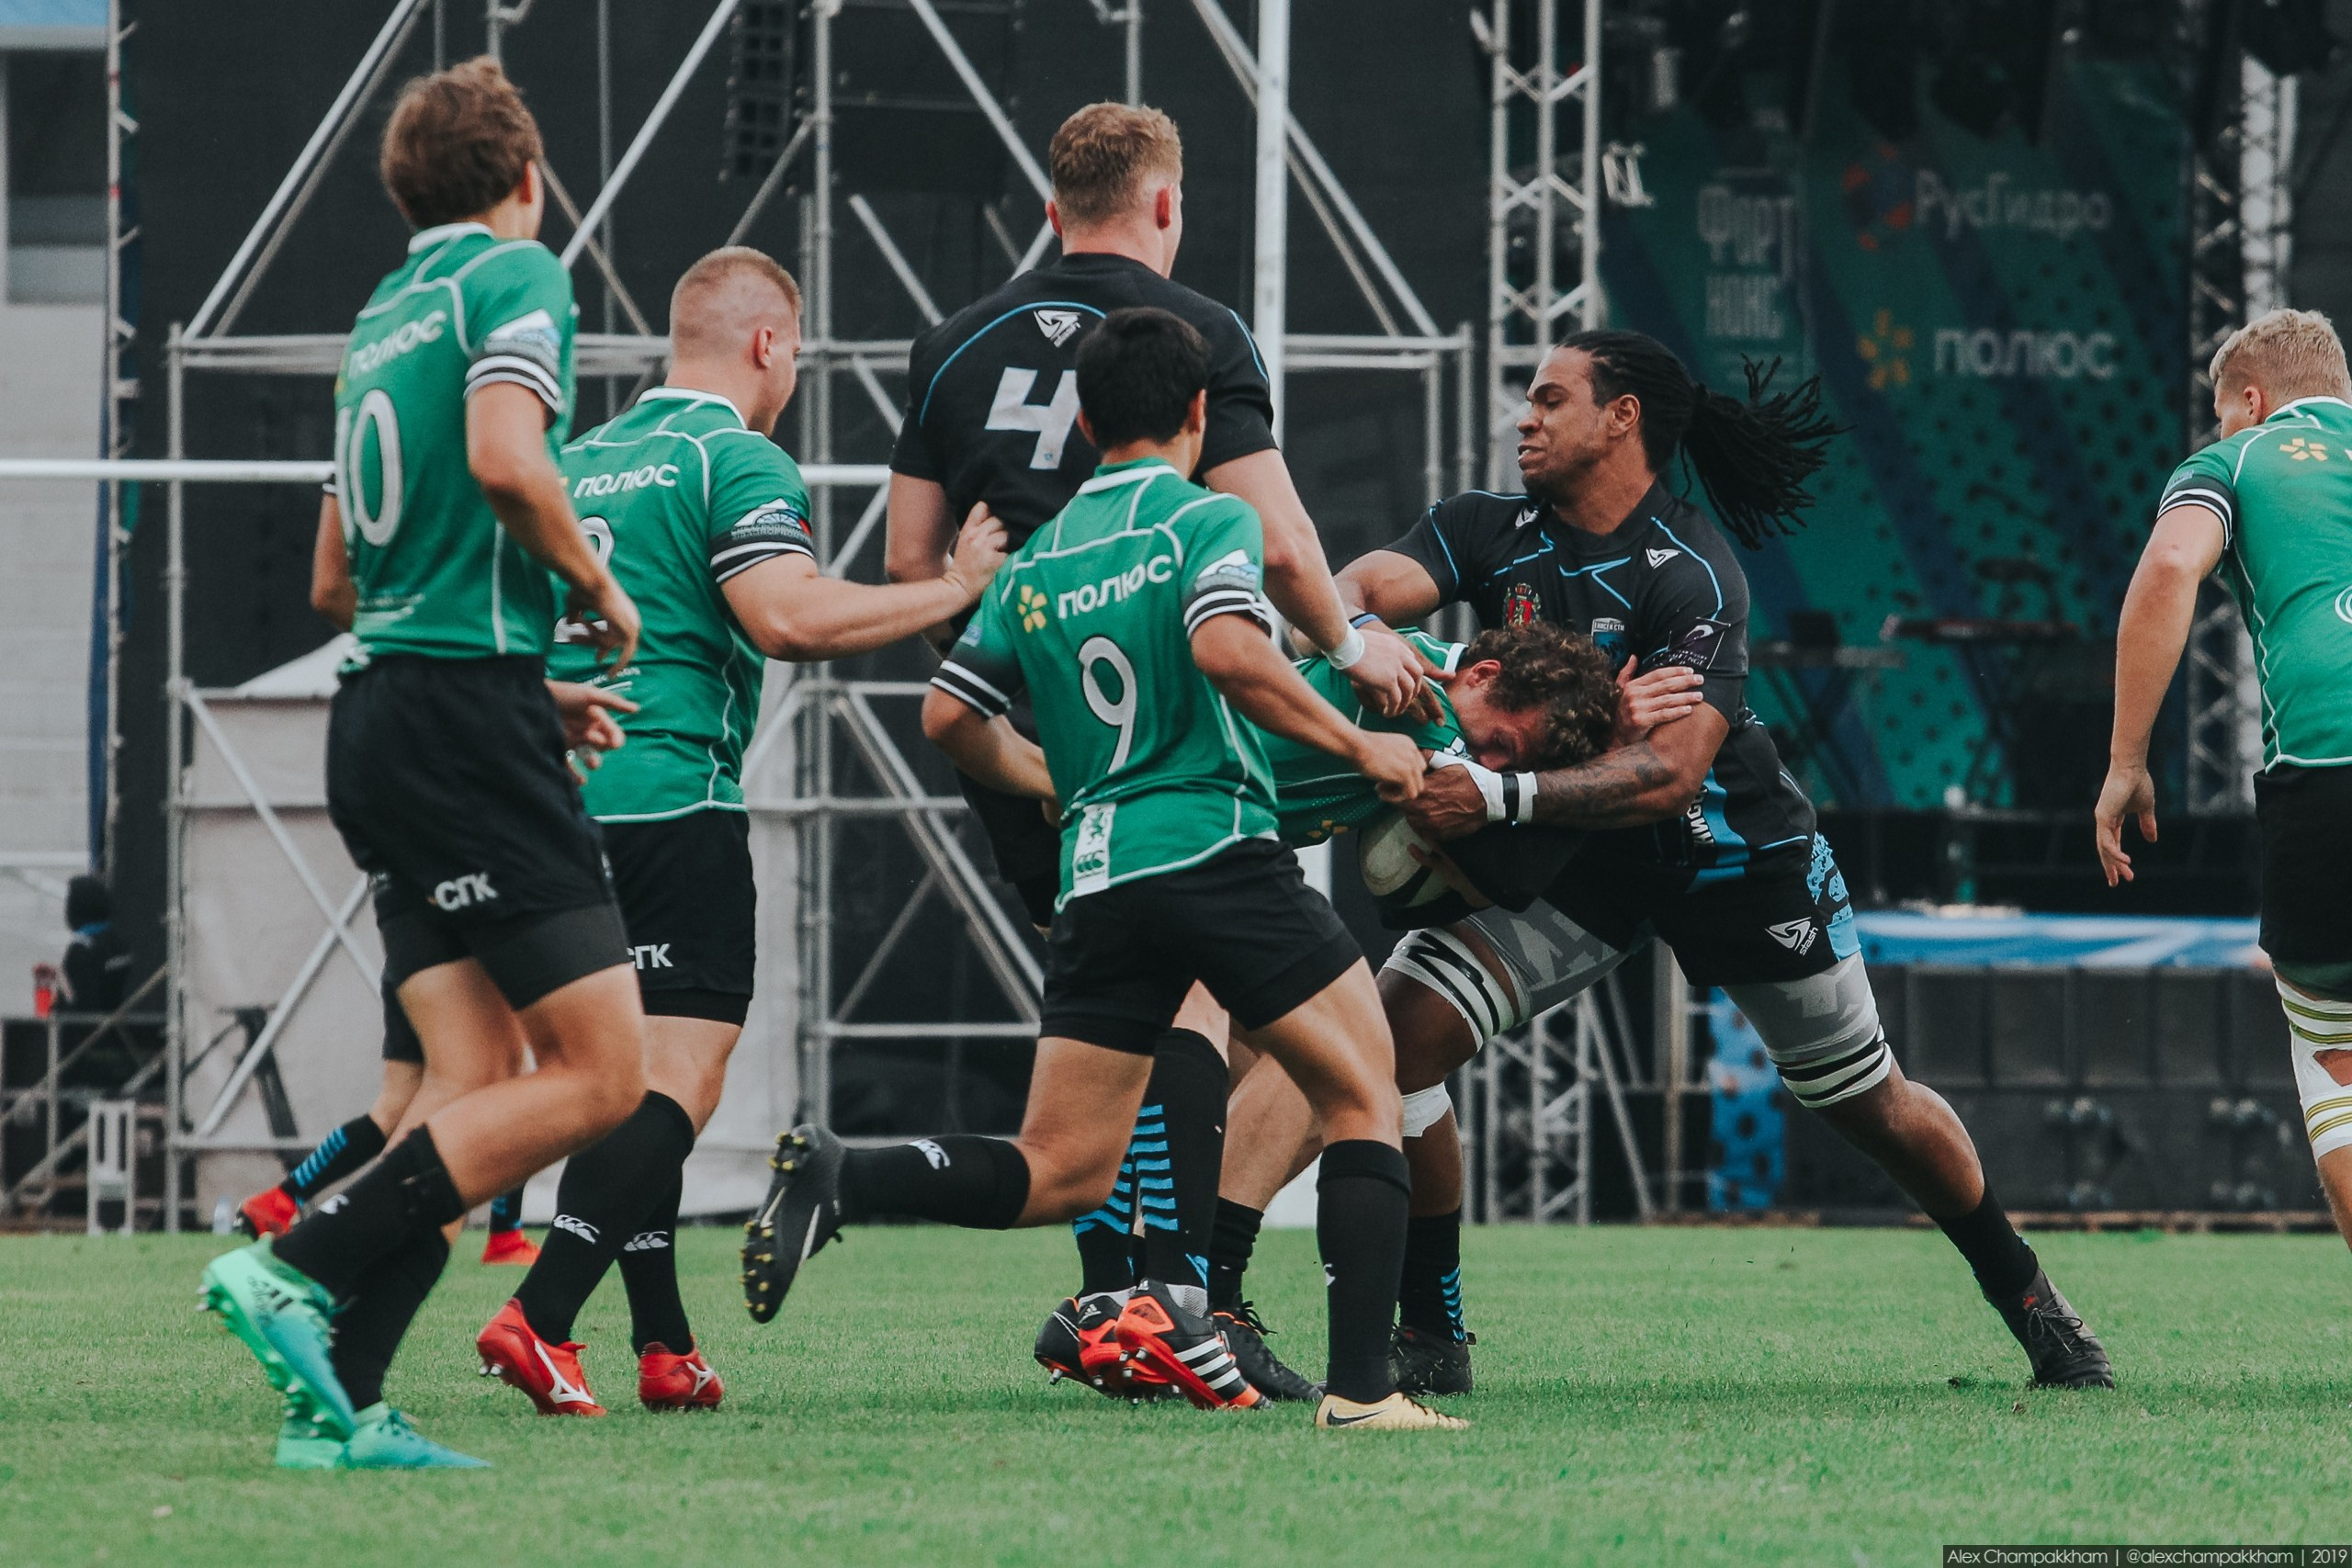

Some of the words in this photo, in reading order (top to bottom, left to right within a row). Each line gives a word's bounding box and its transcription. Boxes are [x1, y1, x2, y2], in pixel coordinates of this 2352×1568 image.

[1915, 170, 2111, 241] РусГидро
[985, 367, 1081, 469] 4
[335, 389, 403, 547] 10
[573, 463, 679, 499] ПОЛЮС
[1057, 554, 1172, 619] ПОЛЮС
[1078, 636, 1137, 775] 9
[435, 873, 498, 911] СГК
[1799, 927, 1818, 955] stash
